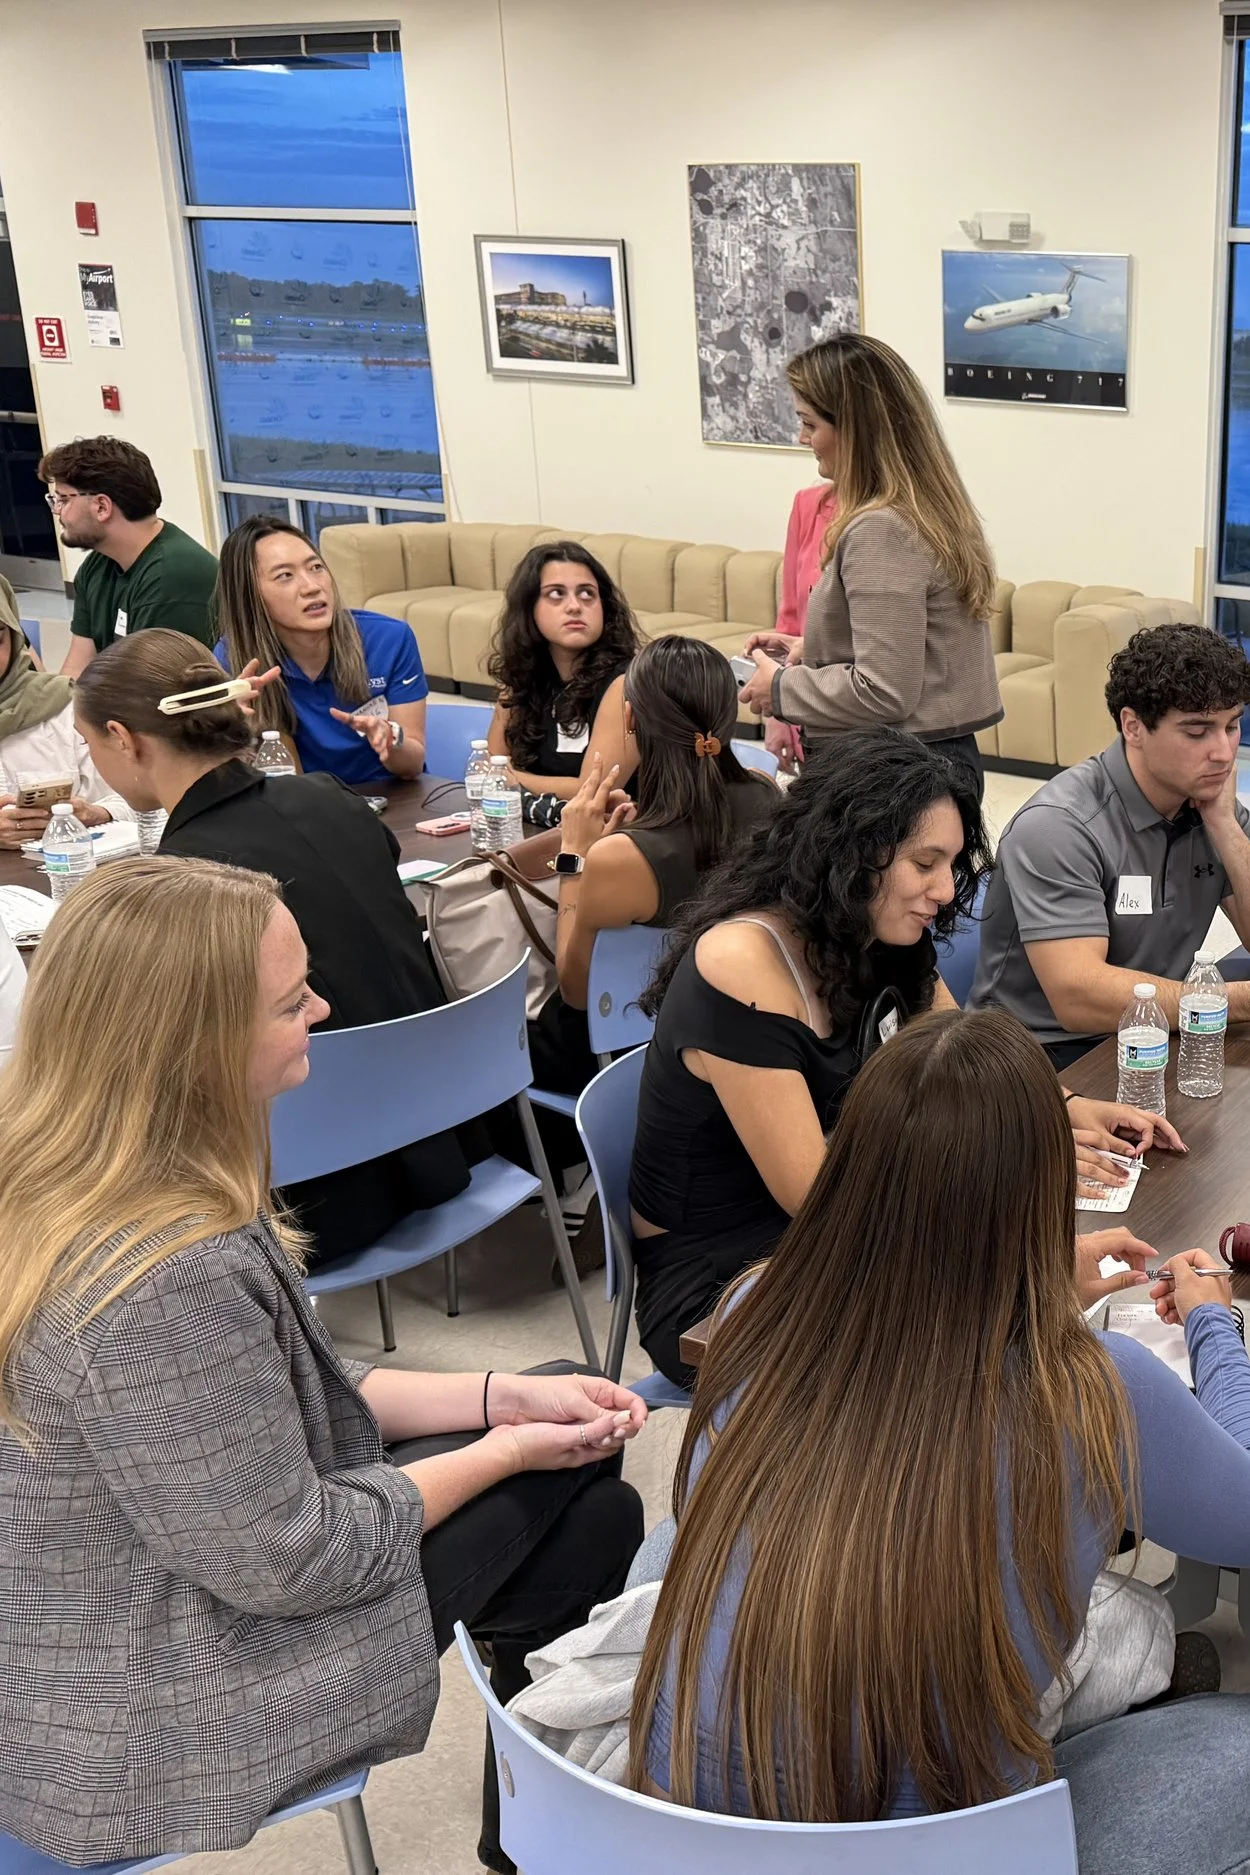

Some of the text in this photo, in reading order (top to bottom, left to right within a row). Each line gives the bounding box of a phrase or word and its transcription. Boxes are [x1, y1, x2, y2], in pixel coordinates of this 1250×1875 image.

[947, 367, 1124, 387] BOEING 717
[1118, 892, 1140, 909] Alex
